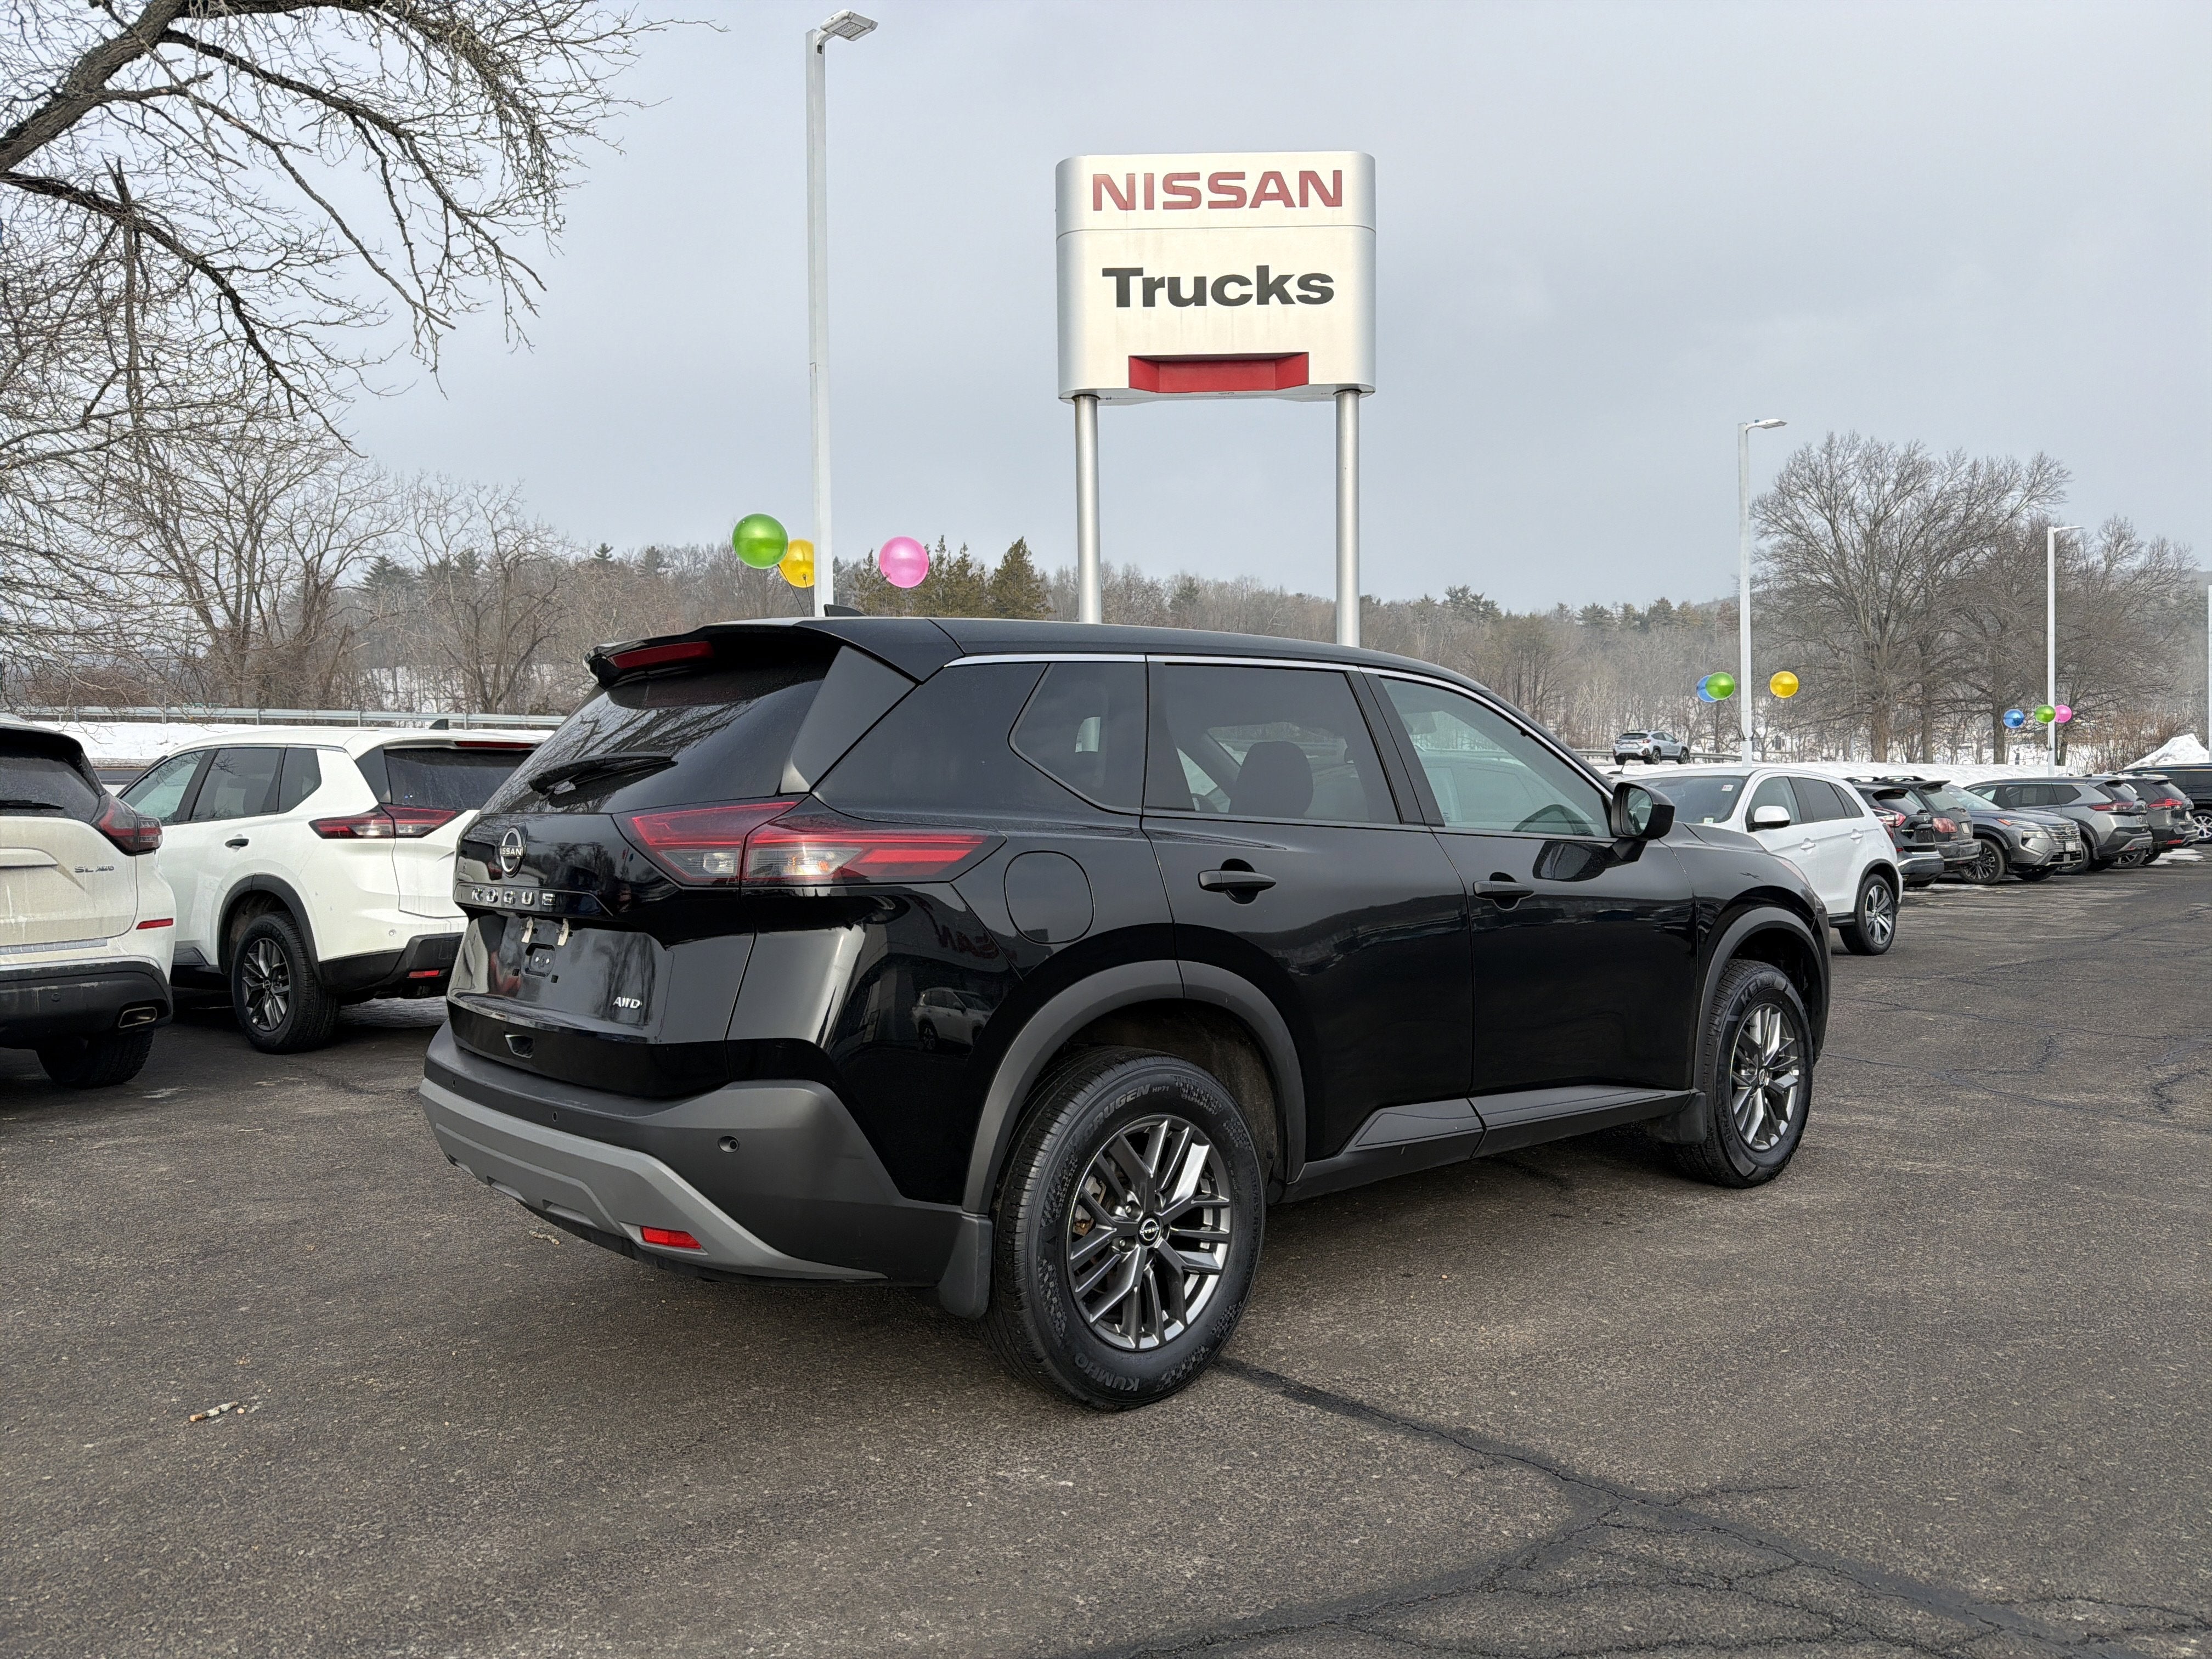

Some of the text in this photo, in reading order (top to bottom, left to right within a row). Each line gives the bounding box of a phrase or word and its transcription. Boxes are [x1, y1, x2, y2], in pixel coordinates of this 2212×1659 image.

[1092, 170, 1343, 211] NISSAN
[1102, 265, 1334, 308] Trucks
[471, 888, 556, 906] ROGUE
[612, 996, 641, 1009] AWD
[1074, 1352, 1140, 1391] KUMHO
